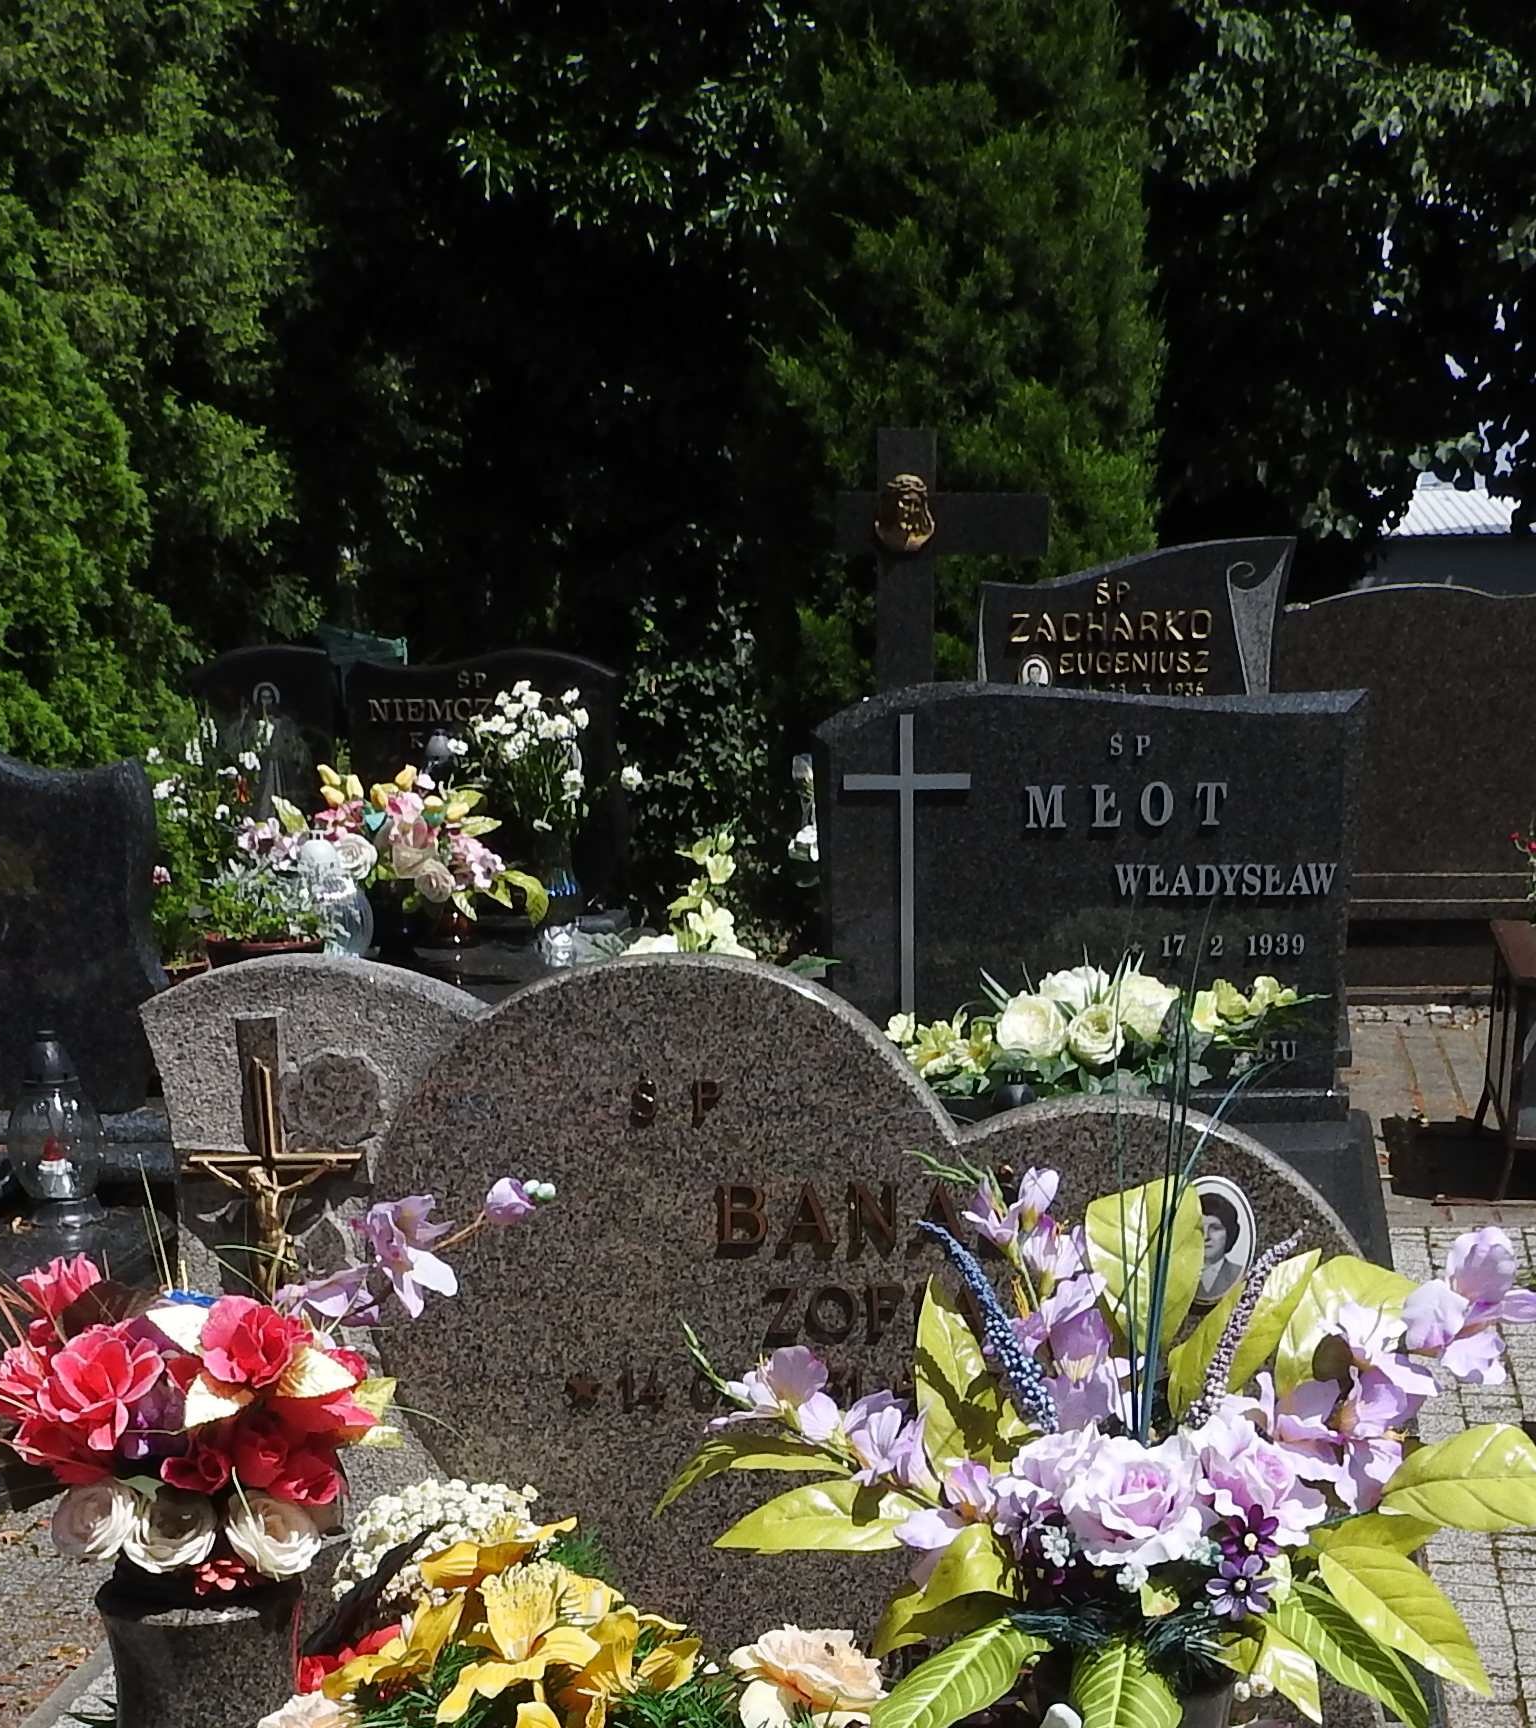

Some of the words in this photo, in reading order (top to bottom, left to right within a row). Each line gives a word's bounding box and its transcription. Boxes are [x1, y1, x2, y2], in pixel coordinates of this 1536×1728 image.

[1010, 609, 1213, 643] ZACHARKO
[1059, 649, 1210, 675] EUGENIUSZ
[1024, 780, 1228, 829] MŁOT
[1114, 861, 1338, 897] WŁADYSŁAW
[1161, 934, 1187, 957] 17
[1210, 934, 1224, 957] 2
[1247, 933, 1305, 957] 1939
[717, 1180, 1020, 1247] BANA
